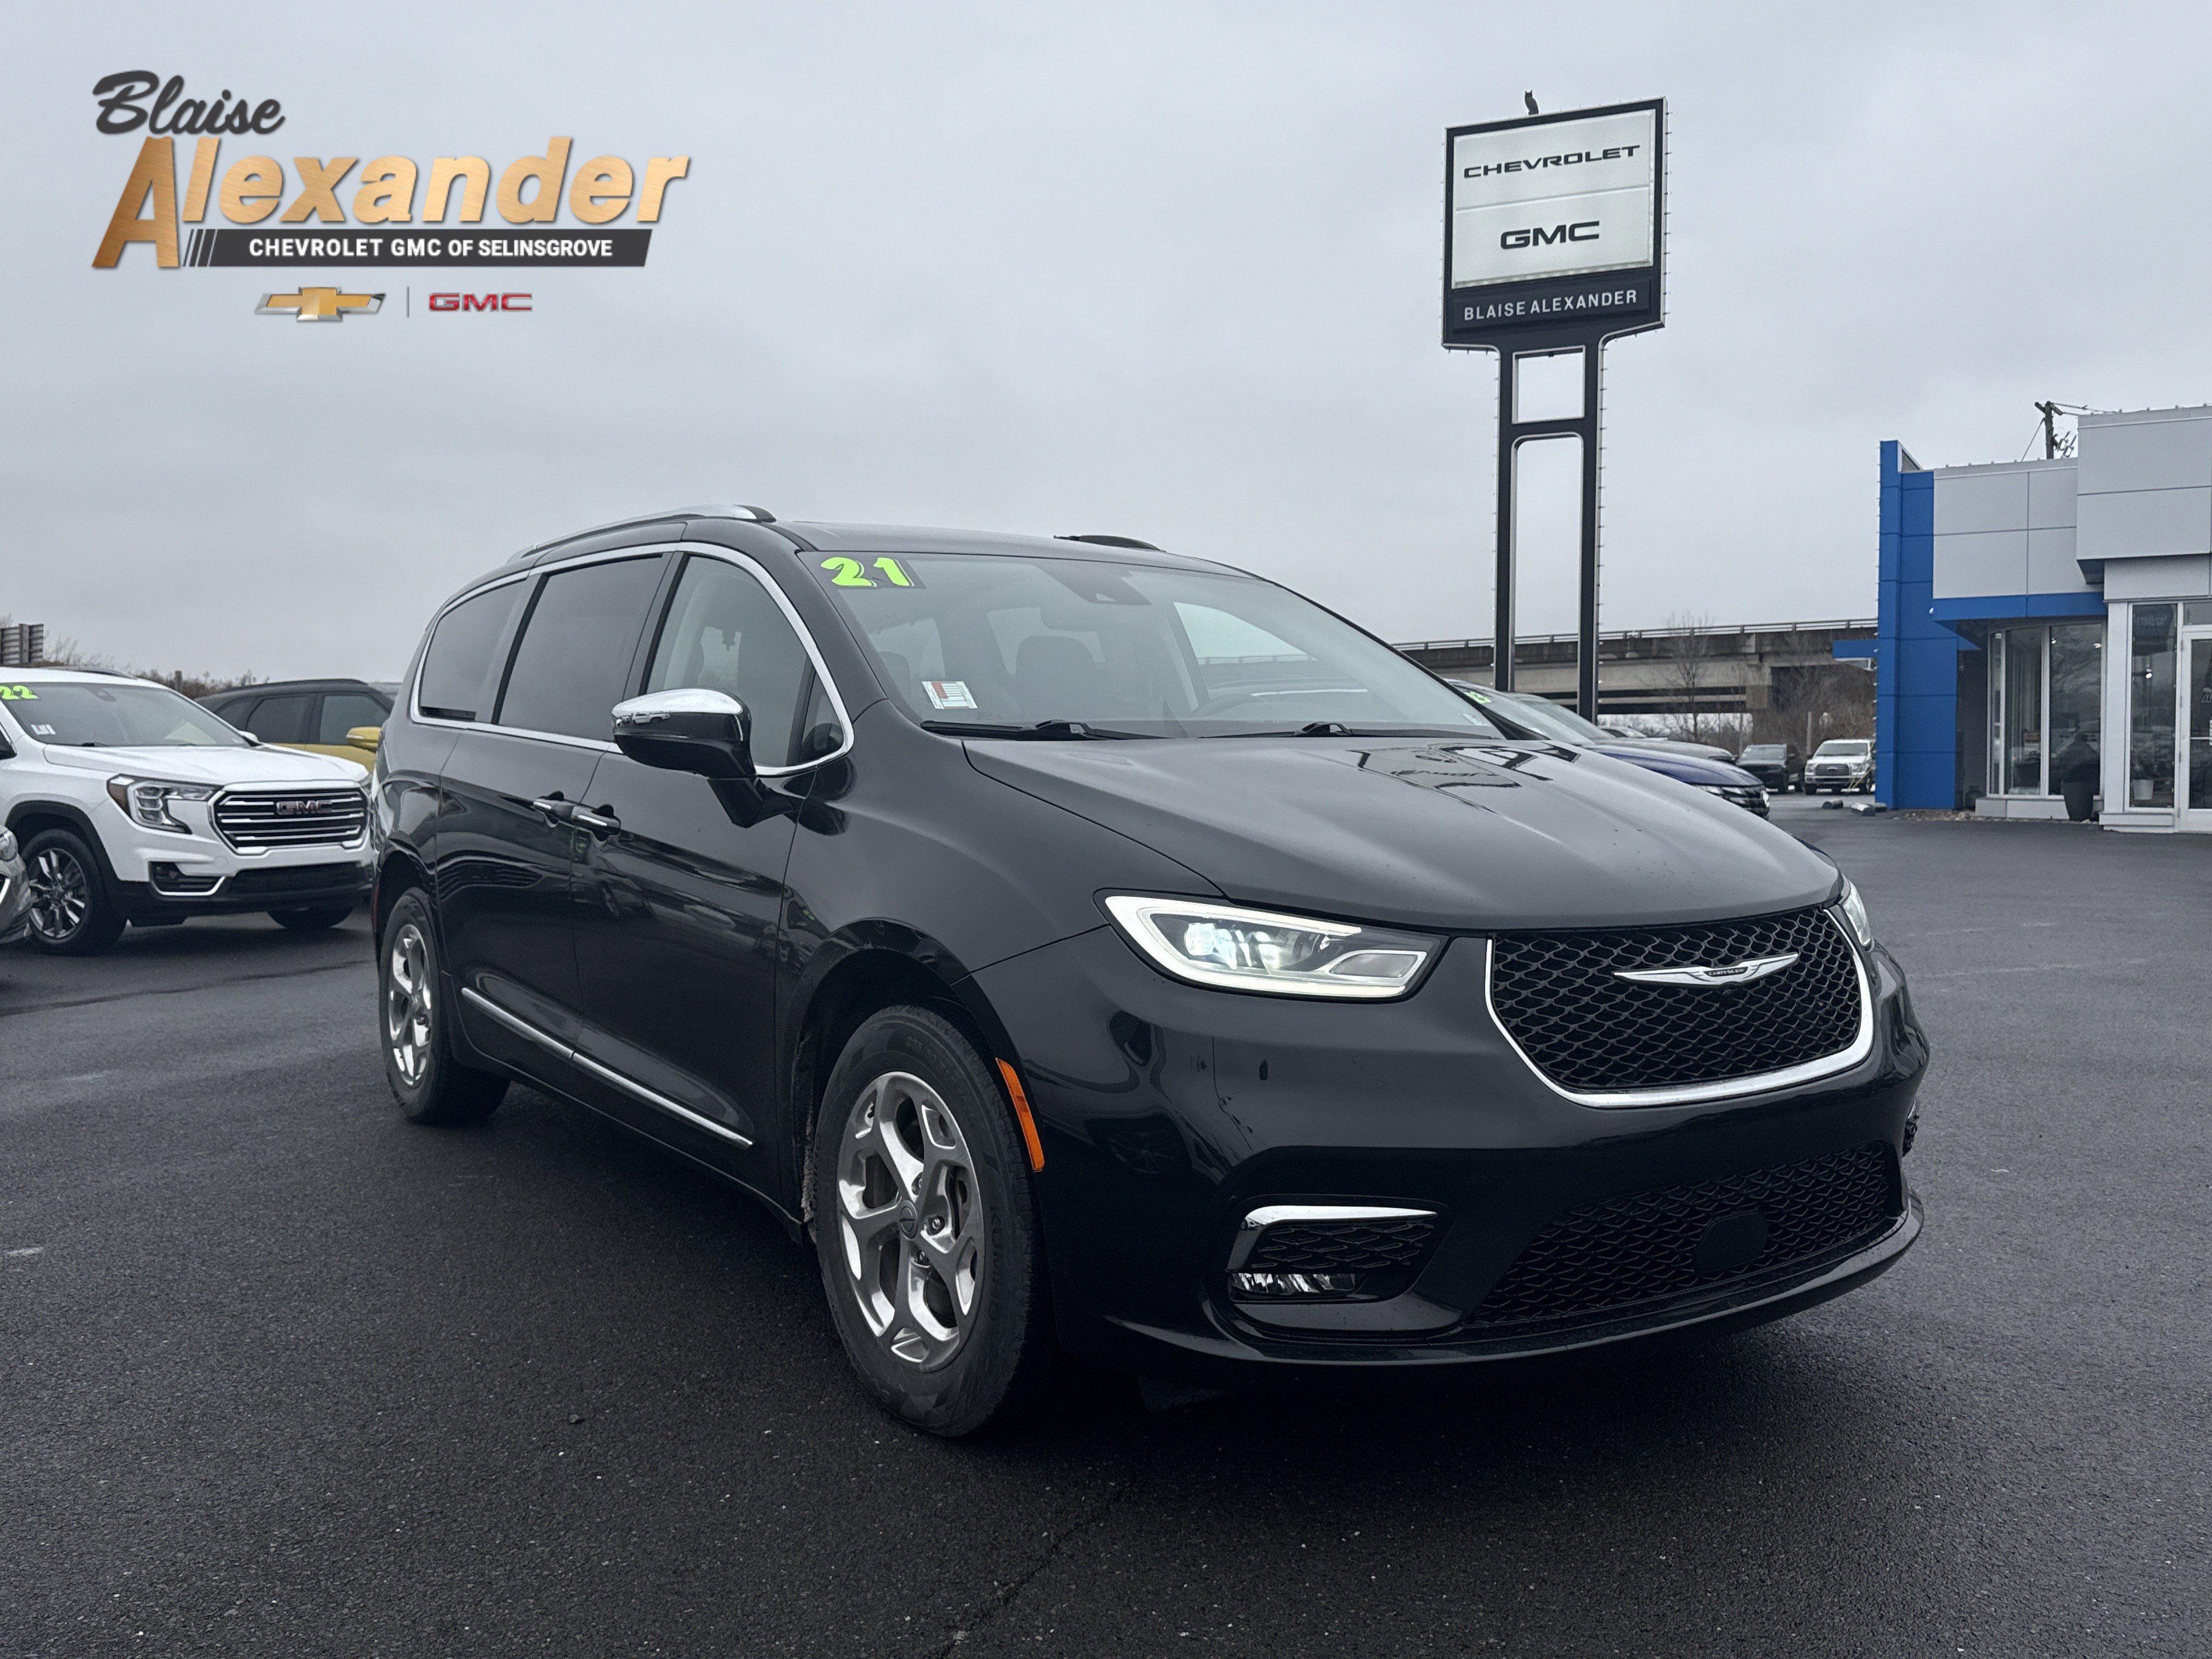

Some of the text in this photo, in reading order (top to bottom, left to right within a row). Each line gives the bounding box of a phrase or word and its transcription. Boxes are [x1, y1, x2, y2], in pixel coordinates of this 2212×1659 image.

[1464, 145, 1640, 178] CHEVROLET
[1500, 221, 1600, 250] GMC
[1464, 289, 1637, 321] BLAISE ALEXANDER
[821, 557, 914, 587] 21
[0, 685, 37, 700] 22
[276, 800, 334, 816] GMC
